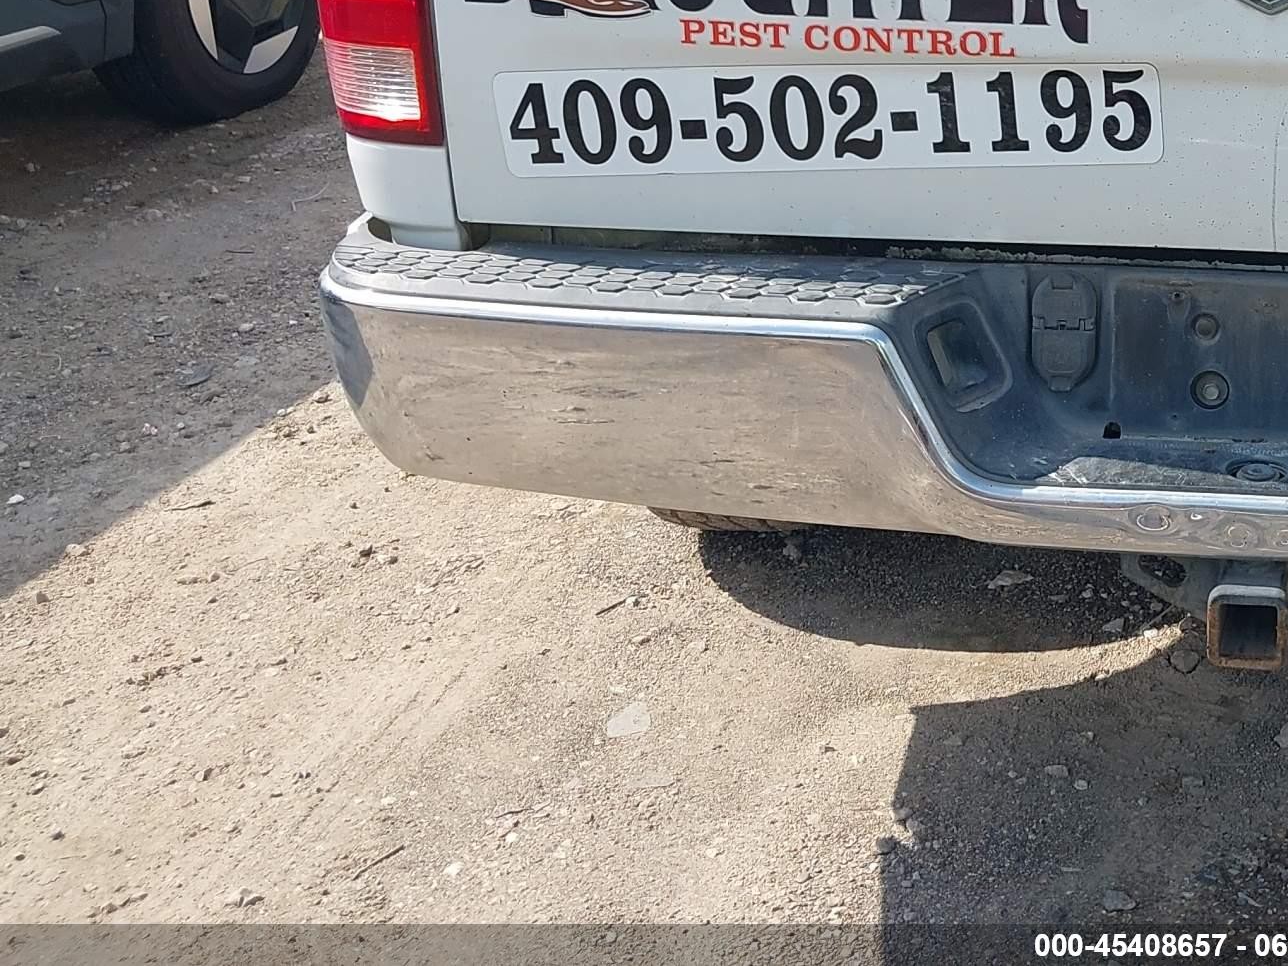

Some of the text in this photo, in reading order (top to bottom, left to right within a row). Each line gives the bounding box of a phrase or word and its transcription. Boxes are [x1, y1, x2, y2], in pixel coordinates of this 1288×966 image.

[680, 19, 1016, 58] PEST CONTROL
[509, 70, 1152, 165] 409-502-1195
